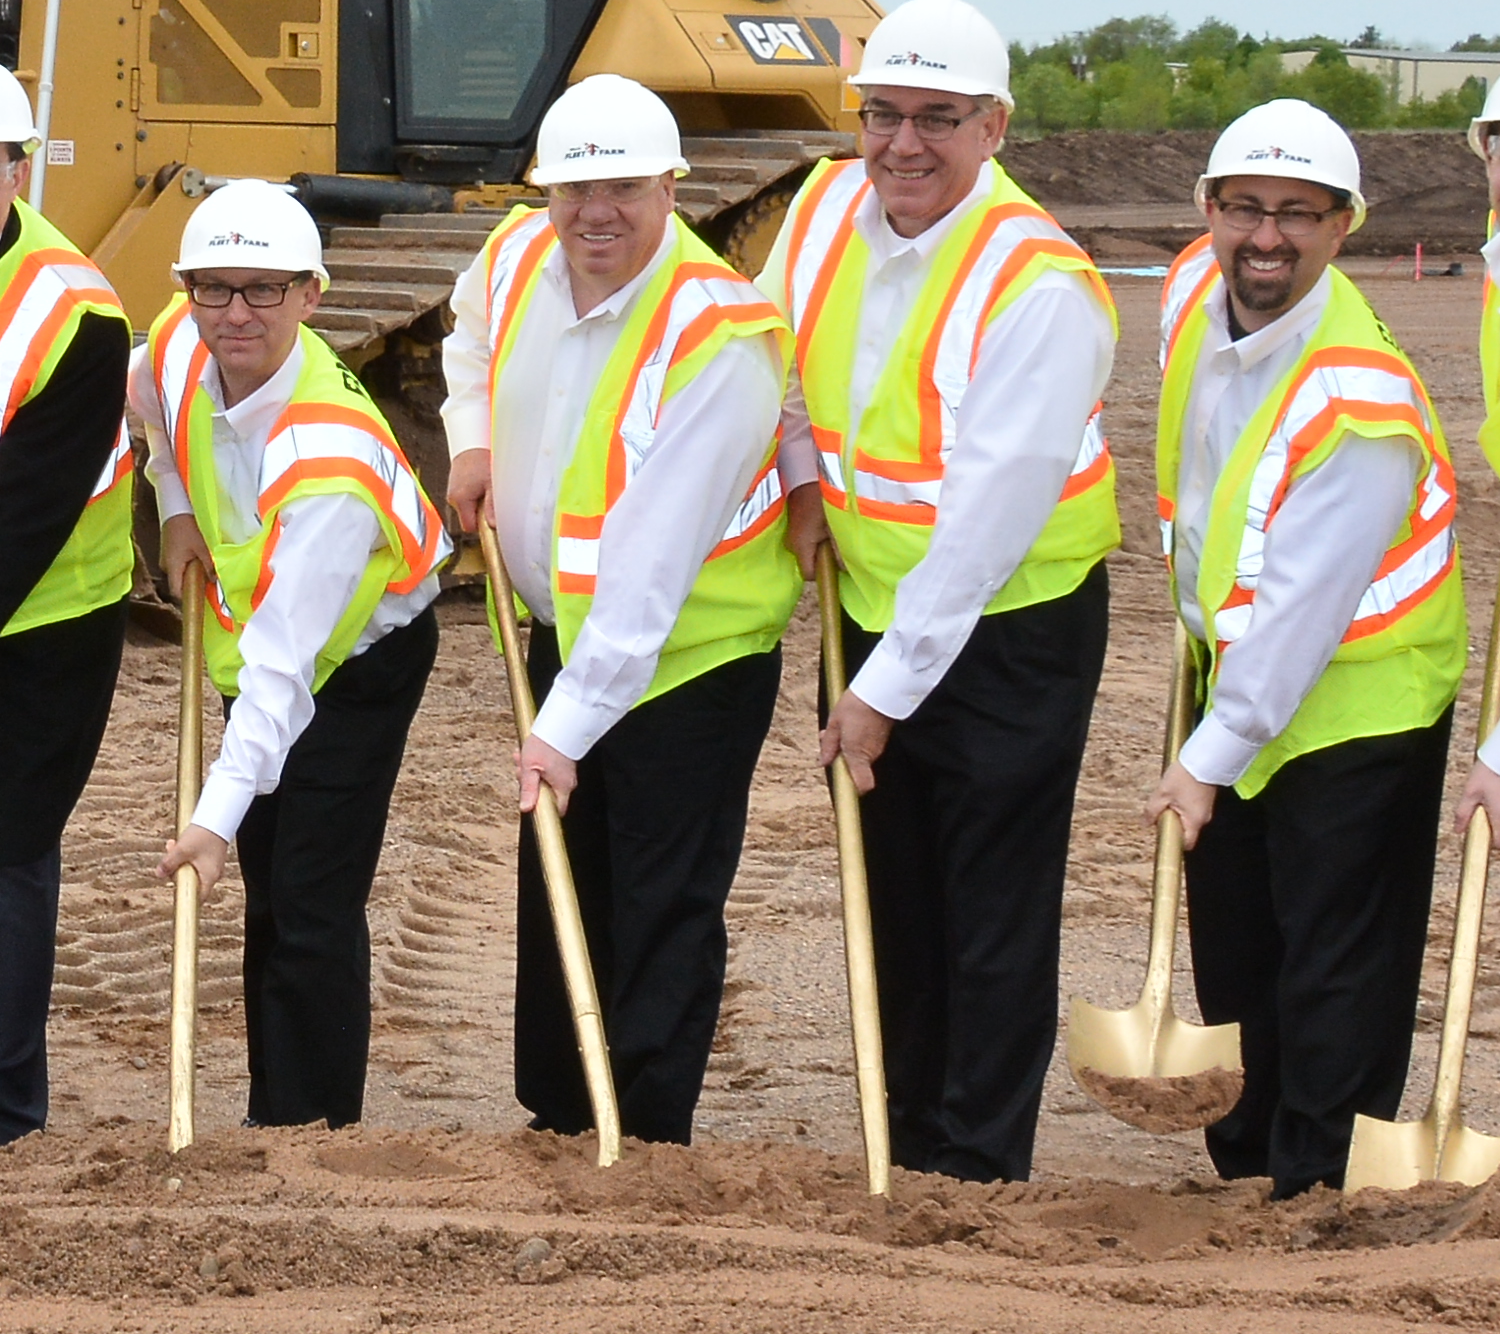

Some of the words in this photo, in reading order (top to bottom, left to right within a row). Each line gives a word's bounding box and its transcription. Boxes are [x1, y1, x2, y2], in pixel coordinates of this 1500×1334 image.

[739, 21, 815, 60] CAT
[921, 60, 947, 69] FARM
[1284, 154, 1311, 163] FARM
